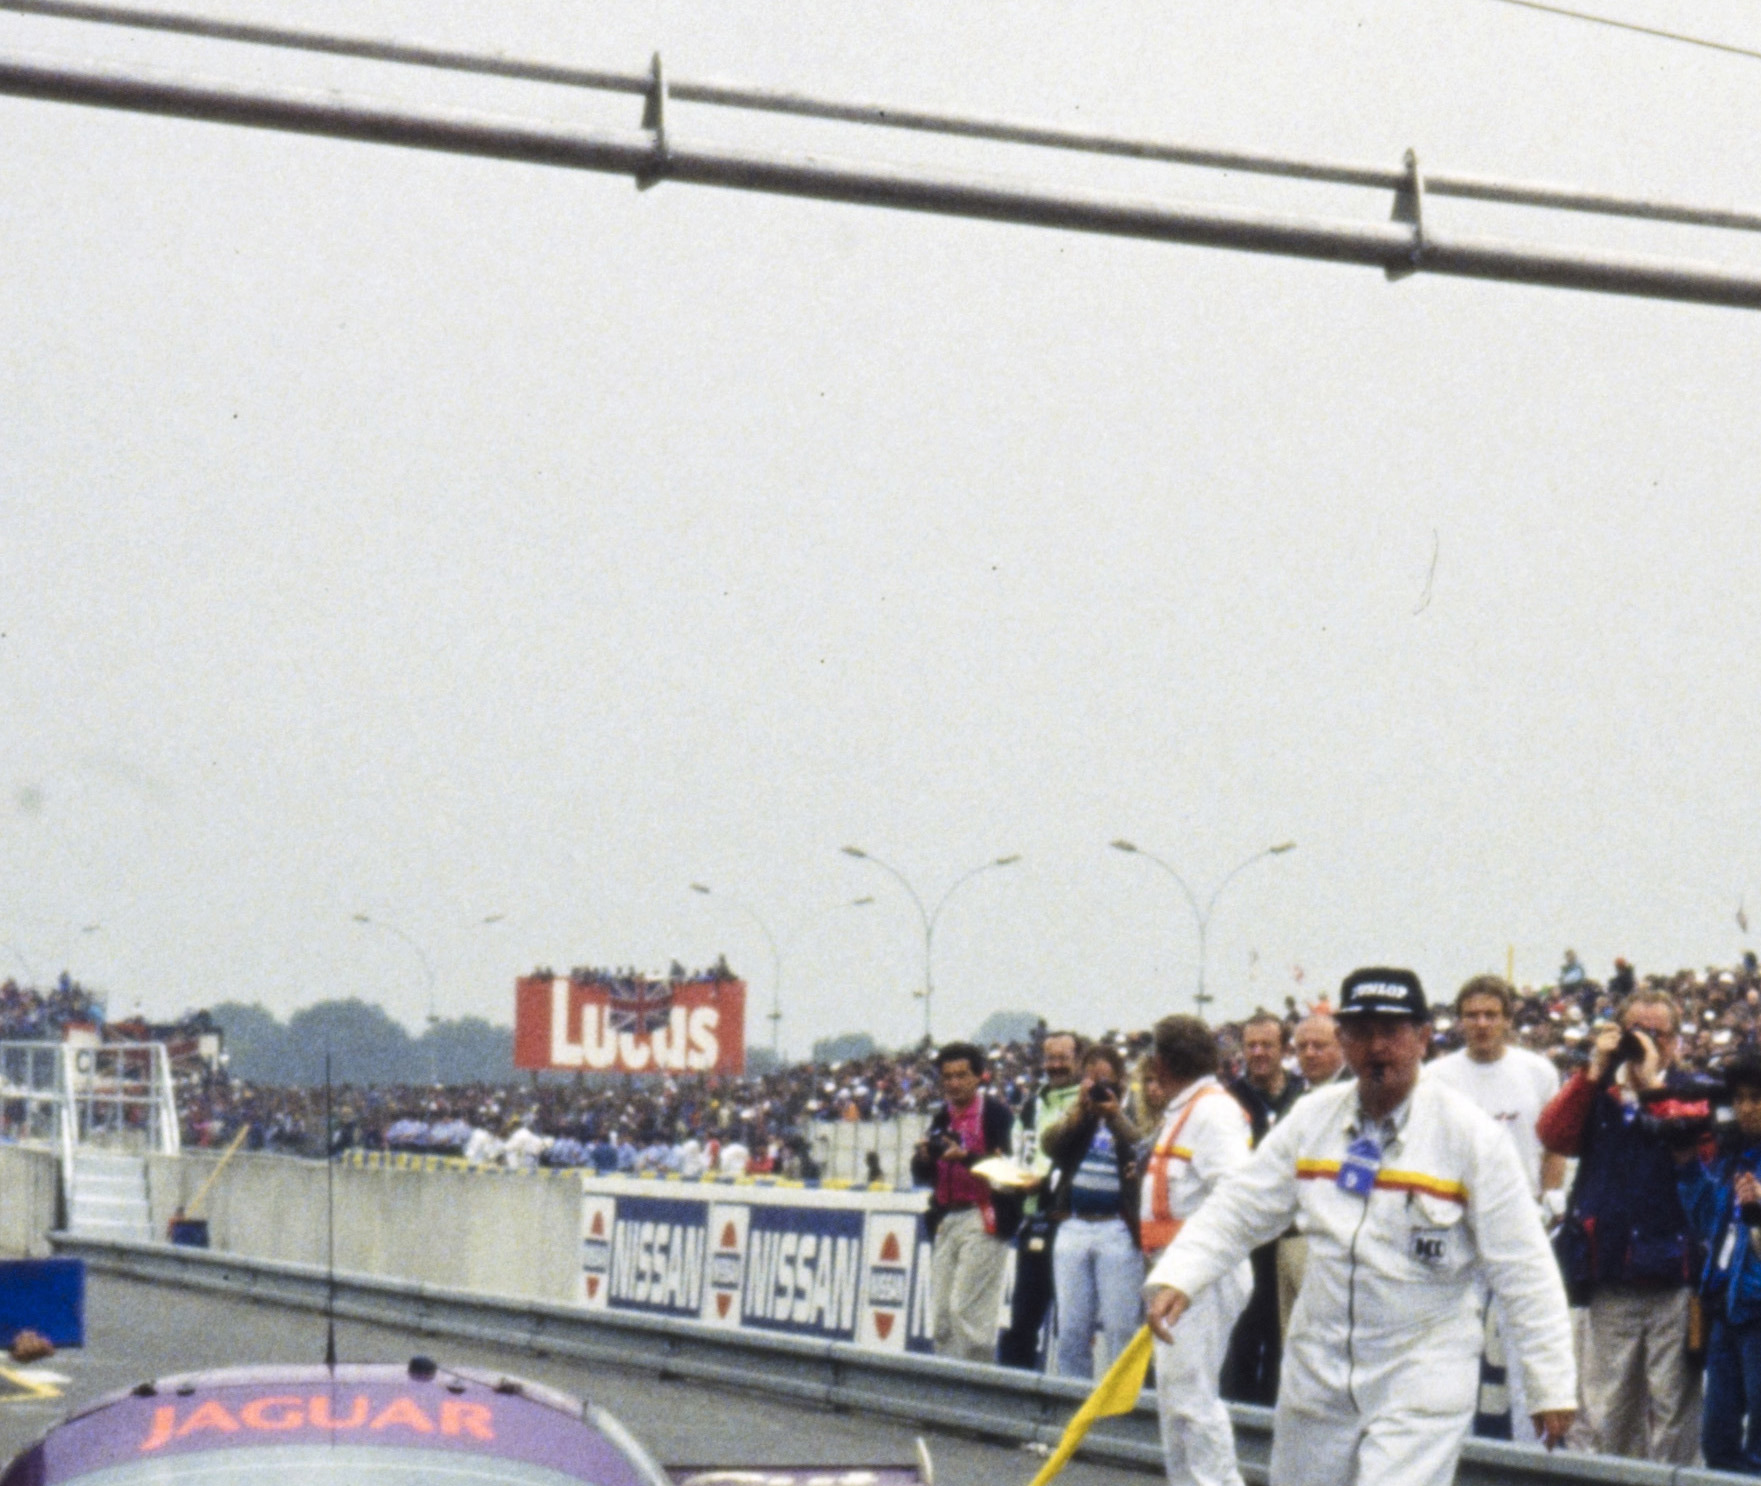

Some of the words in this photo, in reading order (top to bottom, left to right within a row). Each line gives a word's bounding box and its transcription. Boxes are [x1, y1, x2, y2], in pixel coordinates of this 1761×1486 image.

[549, 979, 721, 1071] Lucas
[610, 1219, 707, 1309] NISSAN
[744, 1229, 860, 1331] NISSAN
[140, 1396, 497, 1451] JAGUAR
